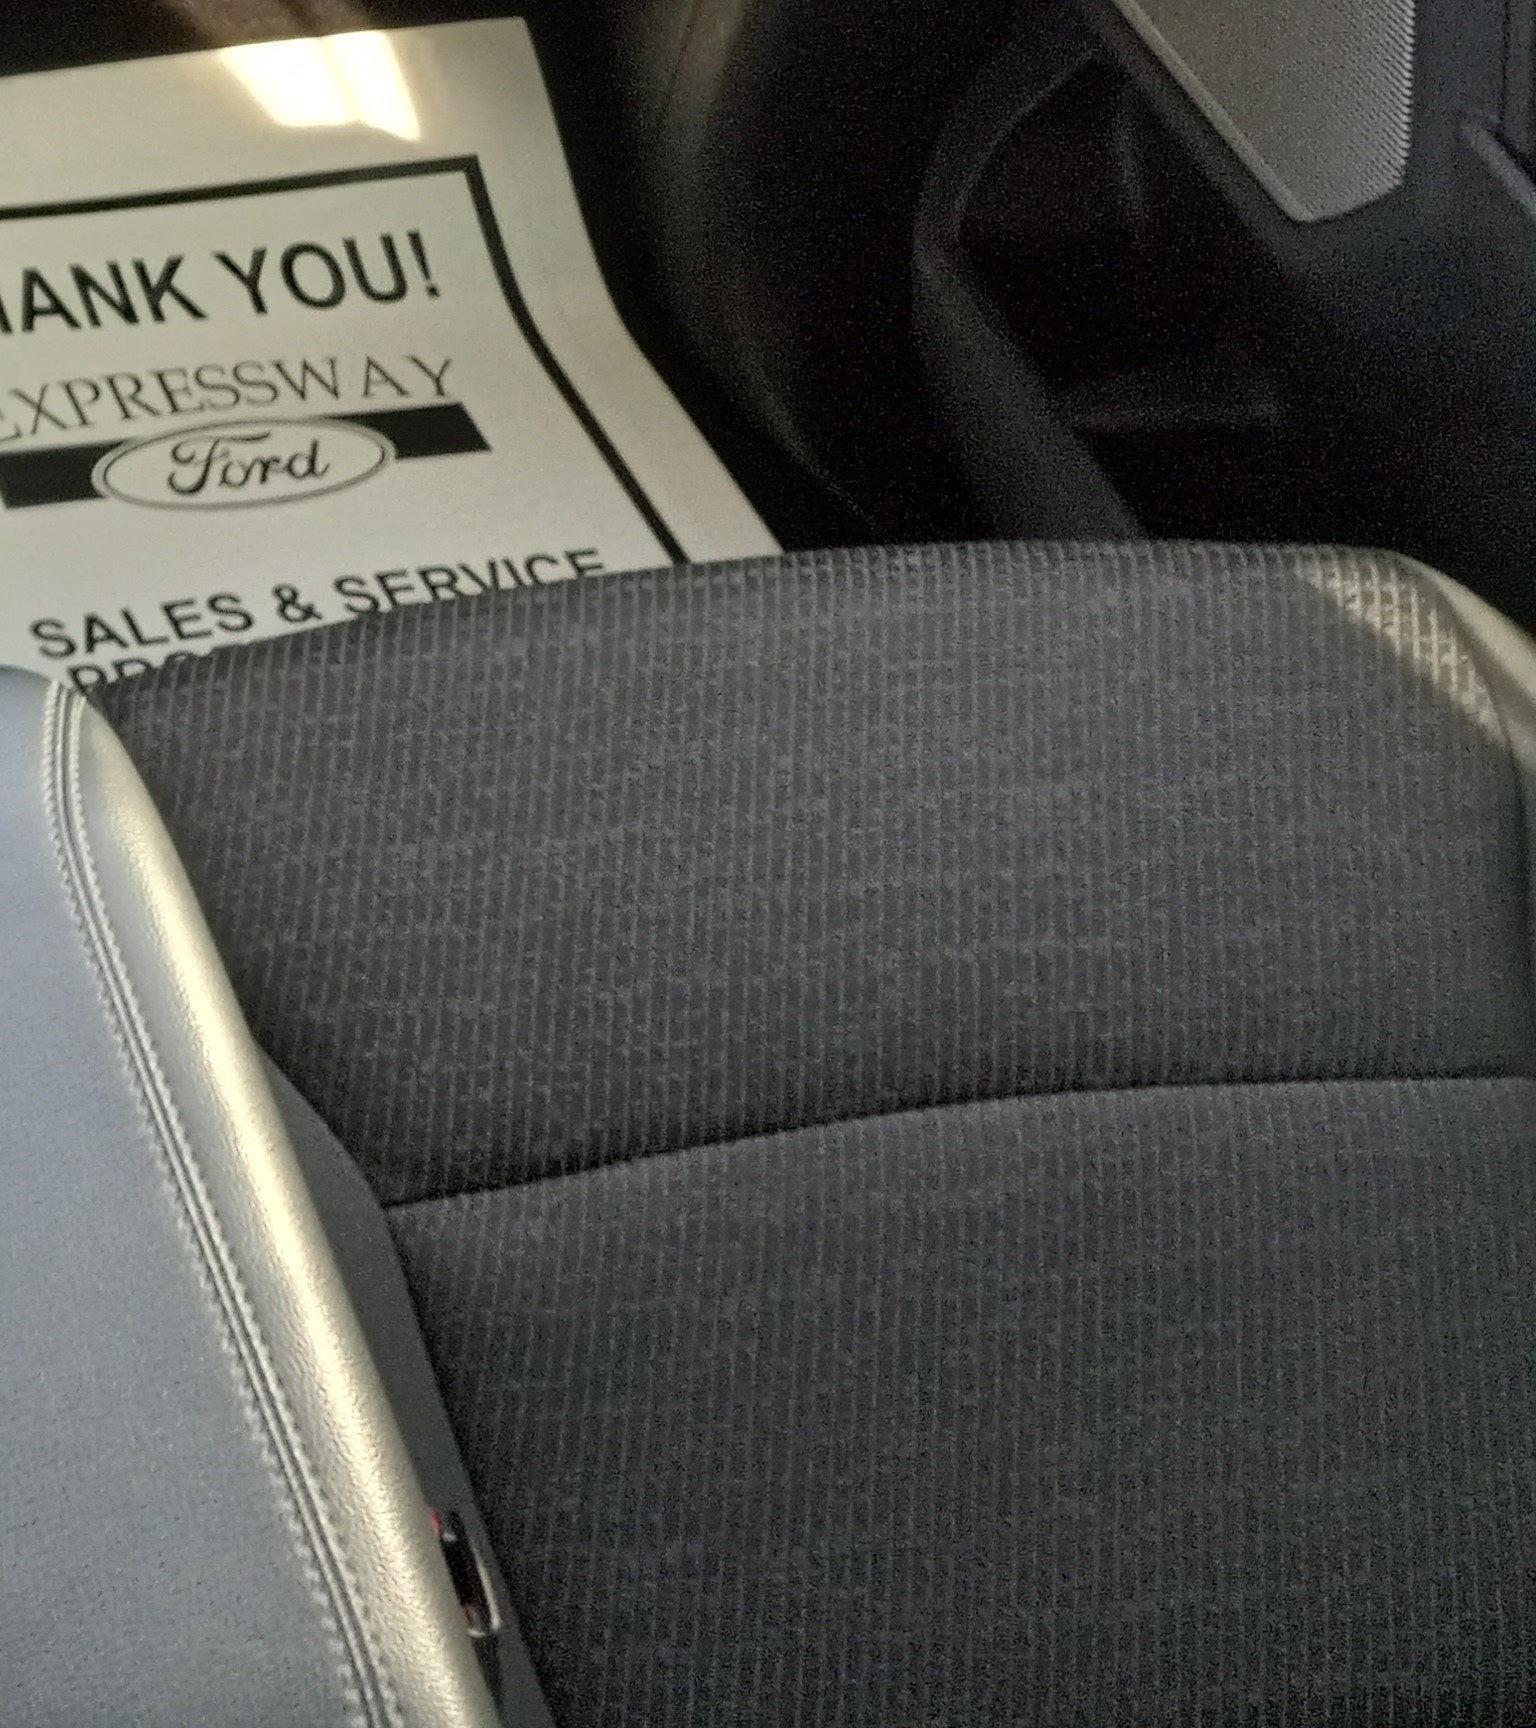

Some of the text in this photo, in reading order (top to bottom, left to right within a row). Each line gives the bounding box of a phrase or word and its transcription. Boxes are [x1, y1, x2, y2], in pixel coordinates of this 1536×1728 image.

[215, 230, 442, 317] YOU!
[166, 428, 332, 498] Ford
[29, 547, 604, 661] SALES & SERVICE
